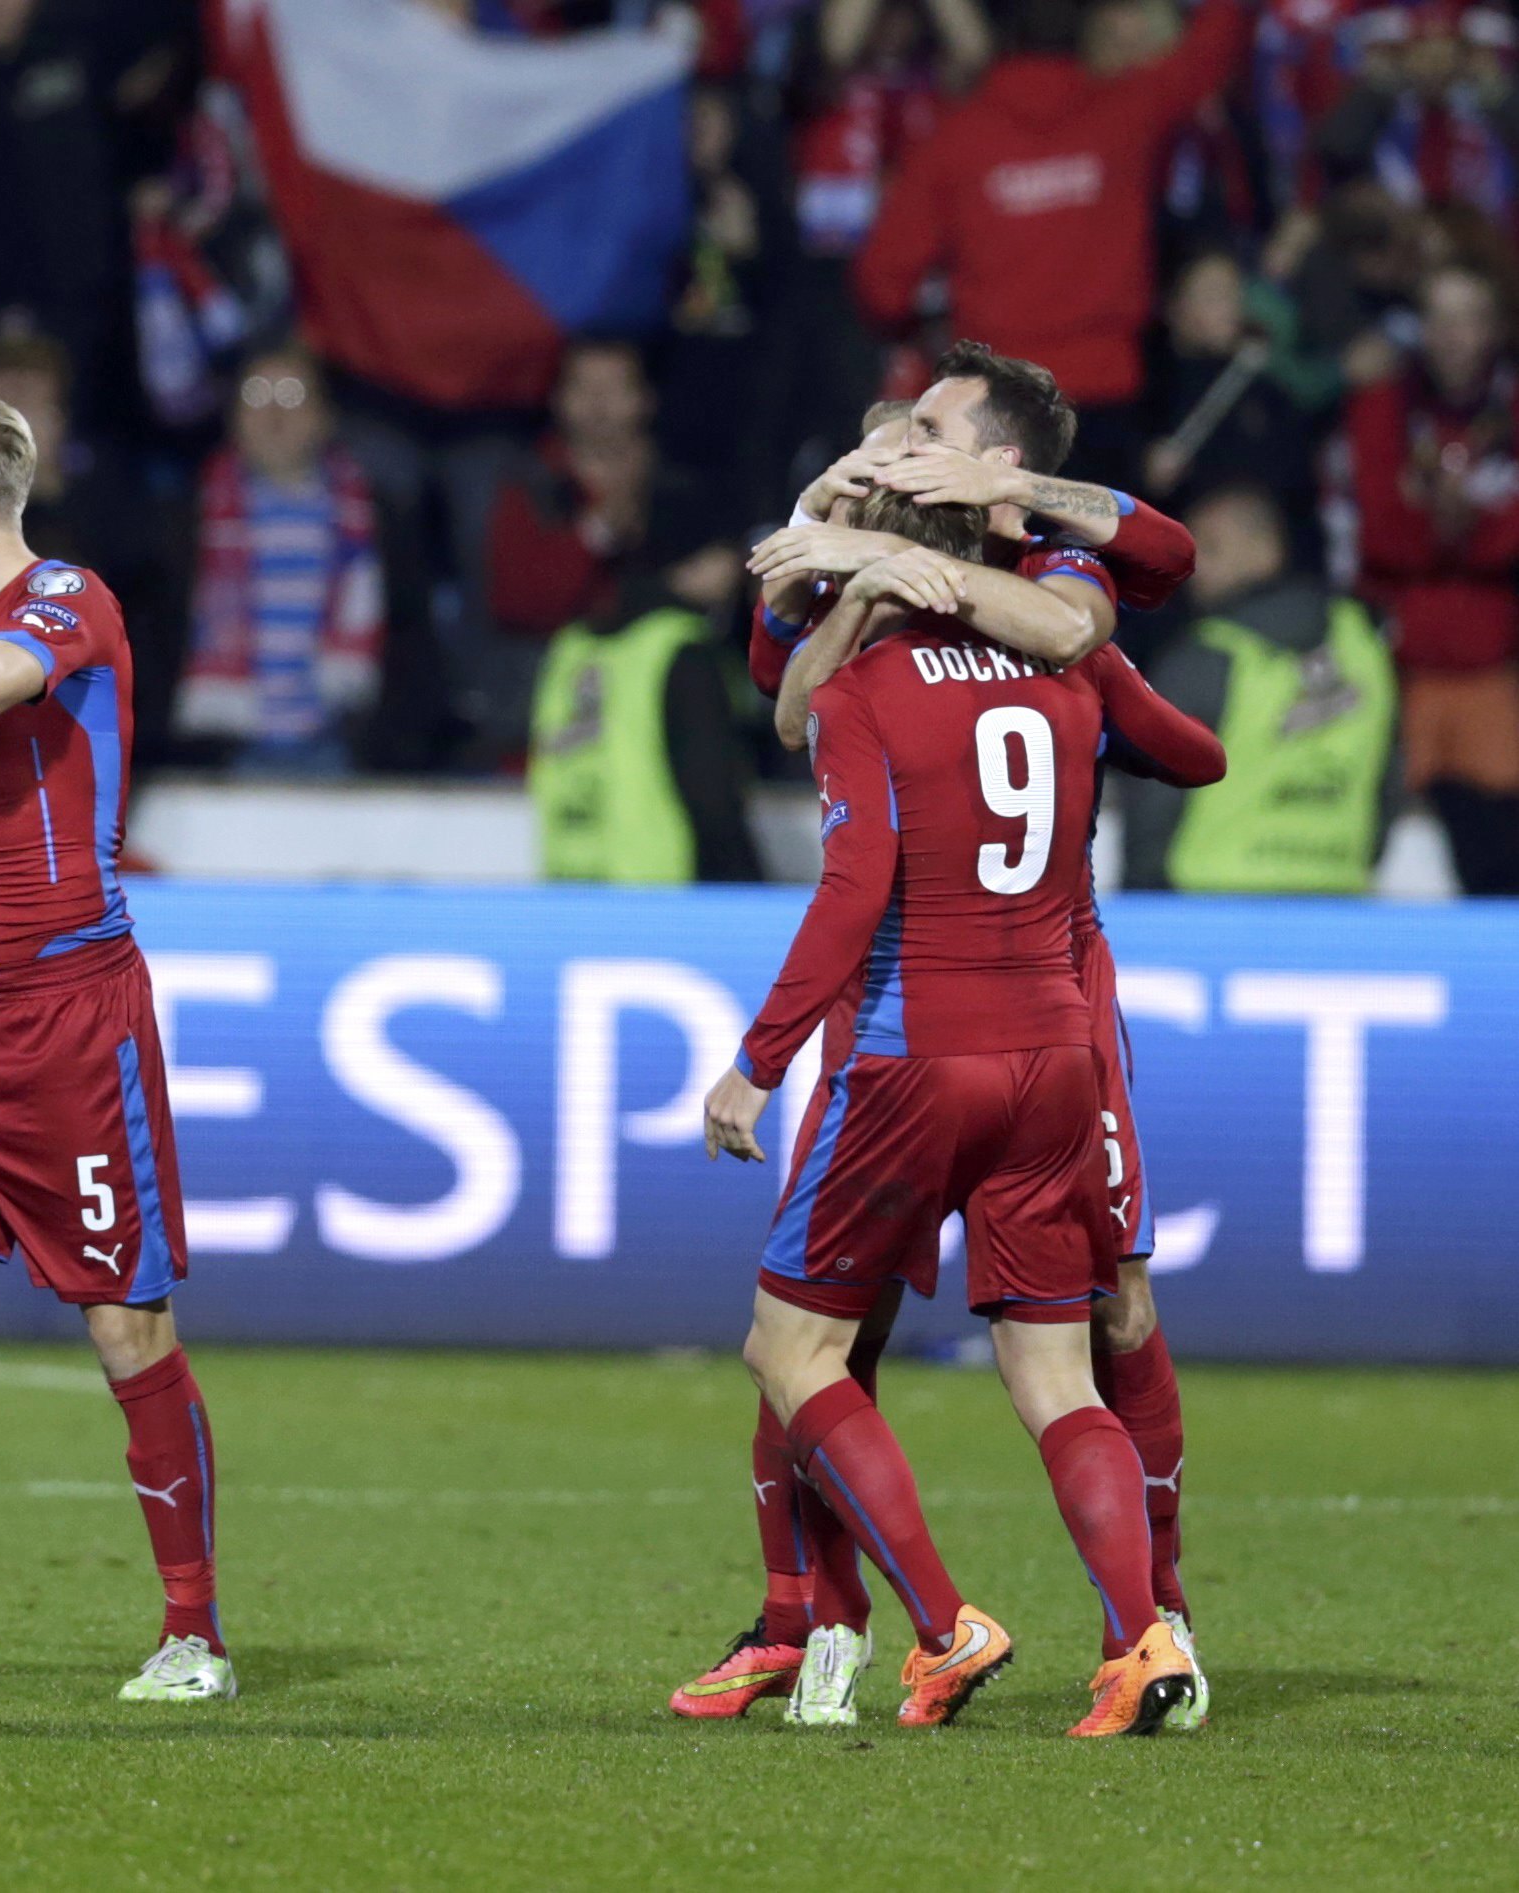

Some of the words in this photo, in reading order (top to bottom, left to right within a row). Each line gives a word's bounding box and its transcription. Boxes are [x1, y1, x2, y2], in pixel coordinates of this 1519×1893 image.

[28, 602, 78, 626] RESPECT
[975, 706, 1055, 895] 9
[76, 1154, 116, 1231] 5
